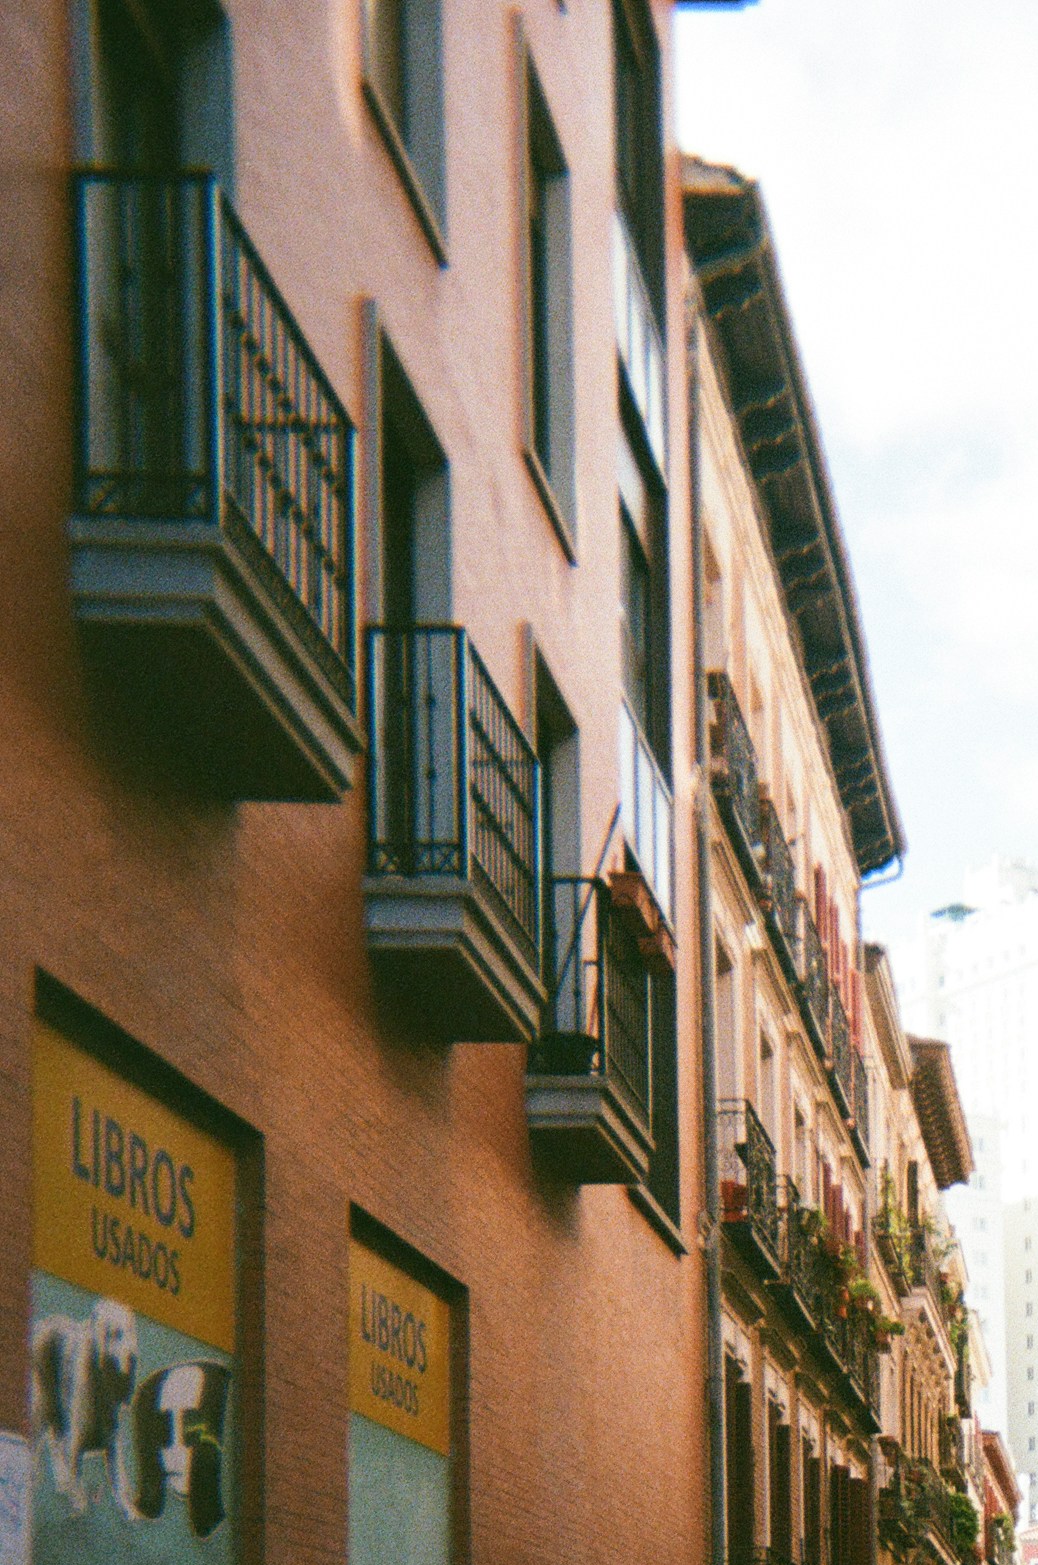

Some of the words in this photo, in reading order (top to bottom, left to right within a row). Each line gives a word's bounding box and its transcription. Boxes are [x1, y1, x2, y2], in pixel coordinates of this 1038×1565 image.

[72, 1096, 196, 1239] LIBROS
[91, 1205, 181, 1296] USADOS
[361, 1283, 427, 1373] LIBROS
[371, 1360, 419, 1416] USADOS
